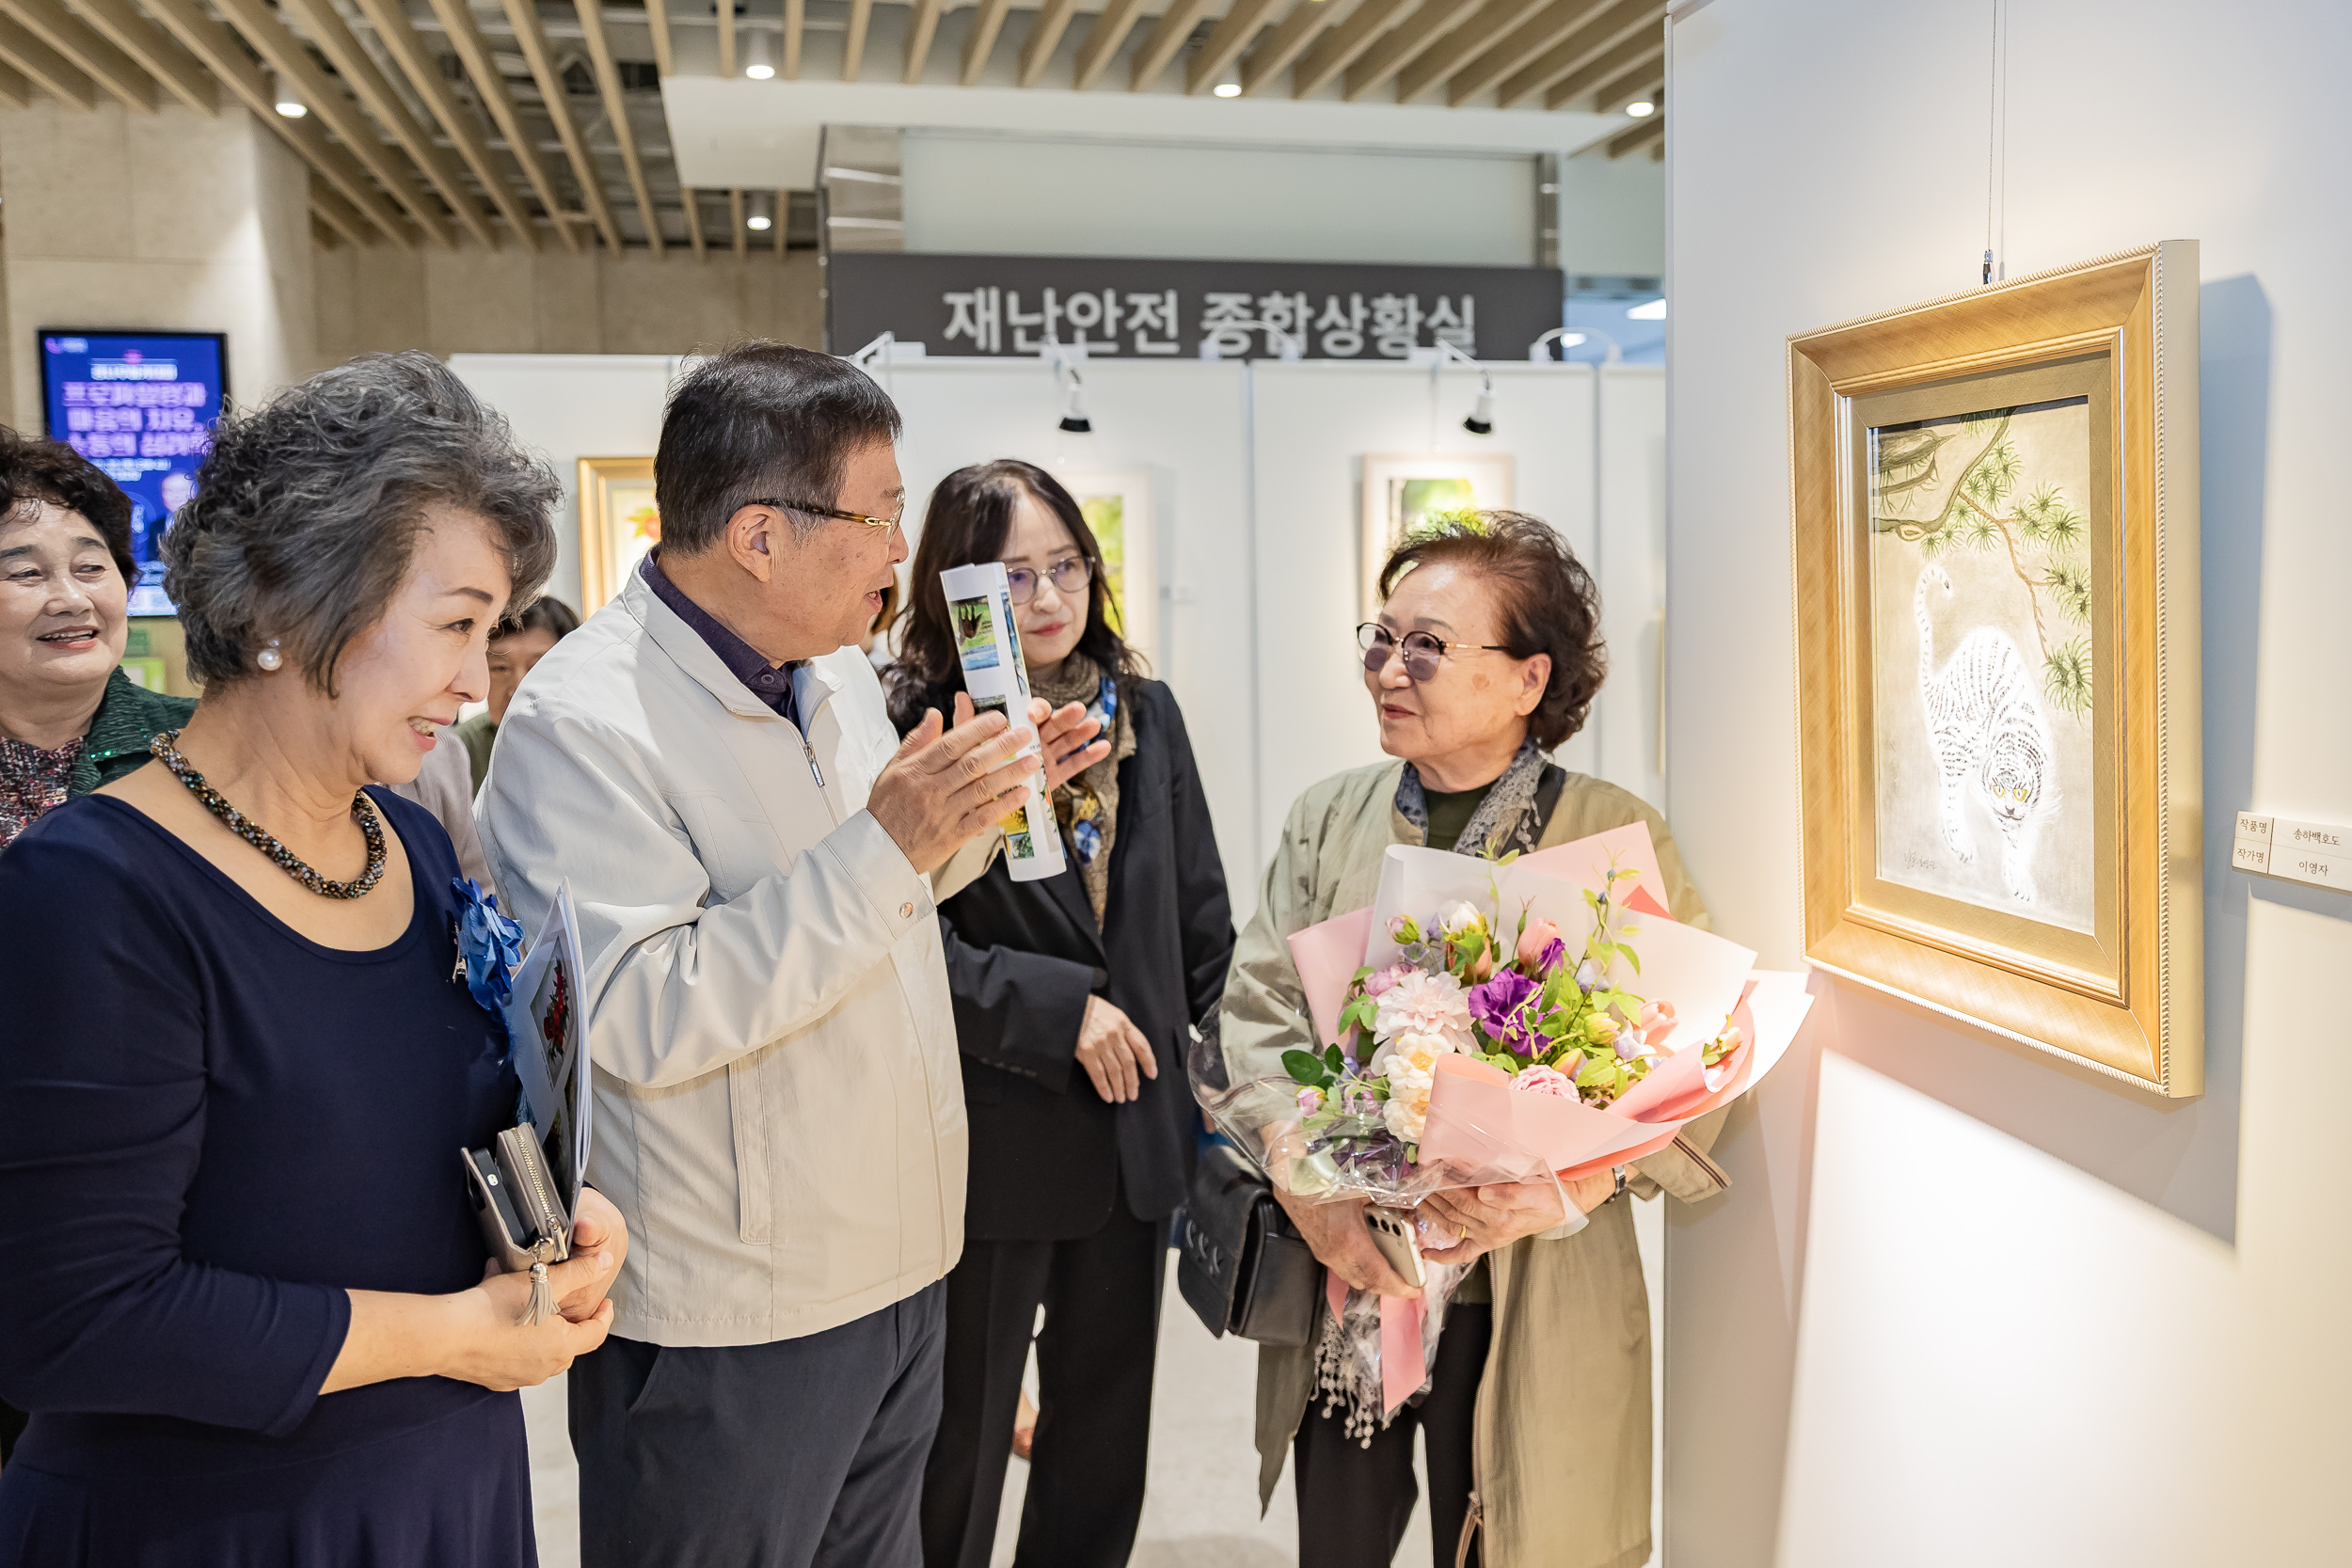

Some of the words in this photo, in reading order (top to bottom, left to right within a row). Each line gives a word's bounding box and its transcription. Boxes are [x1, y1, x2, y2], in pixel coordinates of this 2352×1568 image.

[942, 285, 1181, 355] 재난안전
[1199, 290, 1476, 356] 종합상황실
[2240, 819, 2267, 833] 작품명
[2294, 828, 2340, 847] 송하백호도
[2237, 848, 2265, 863] 작가명
[2298, 861, 2328, 877] 이영자
